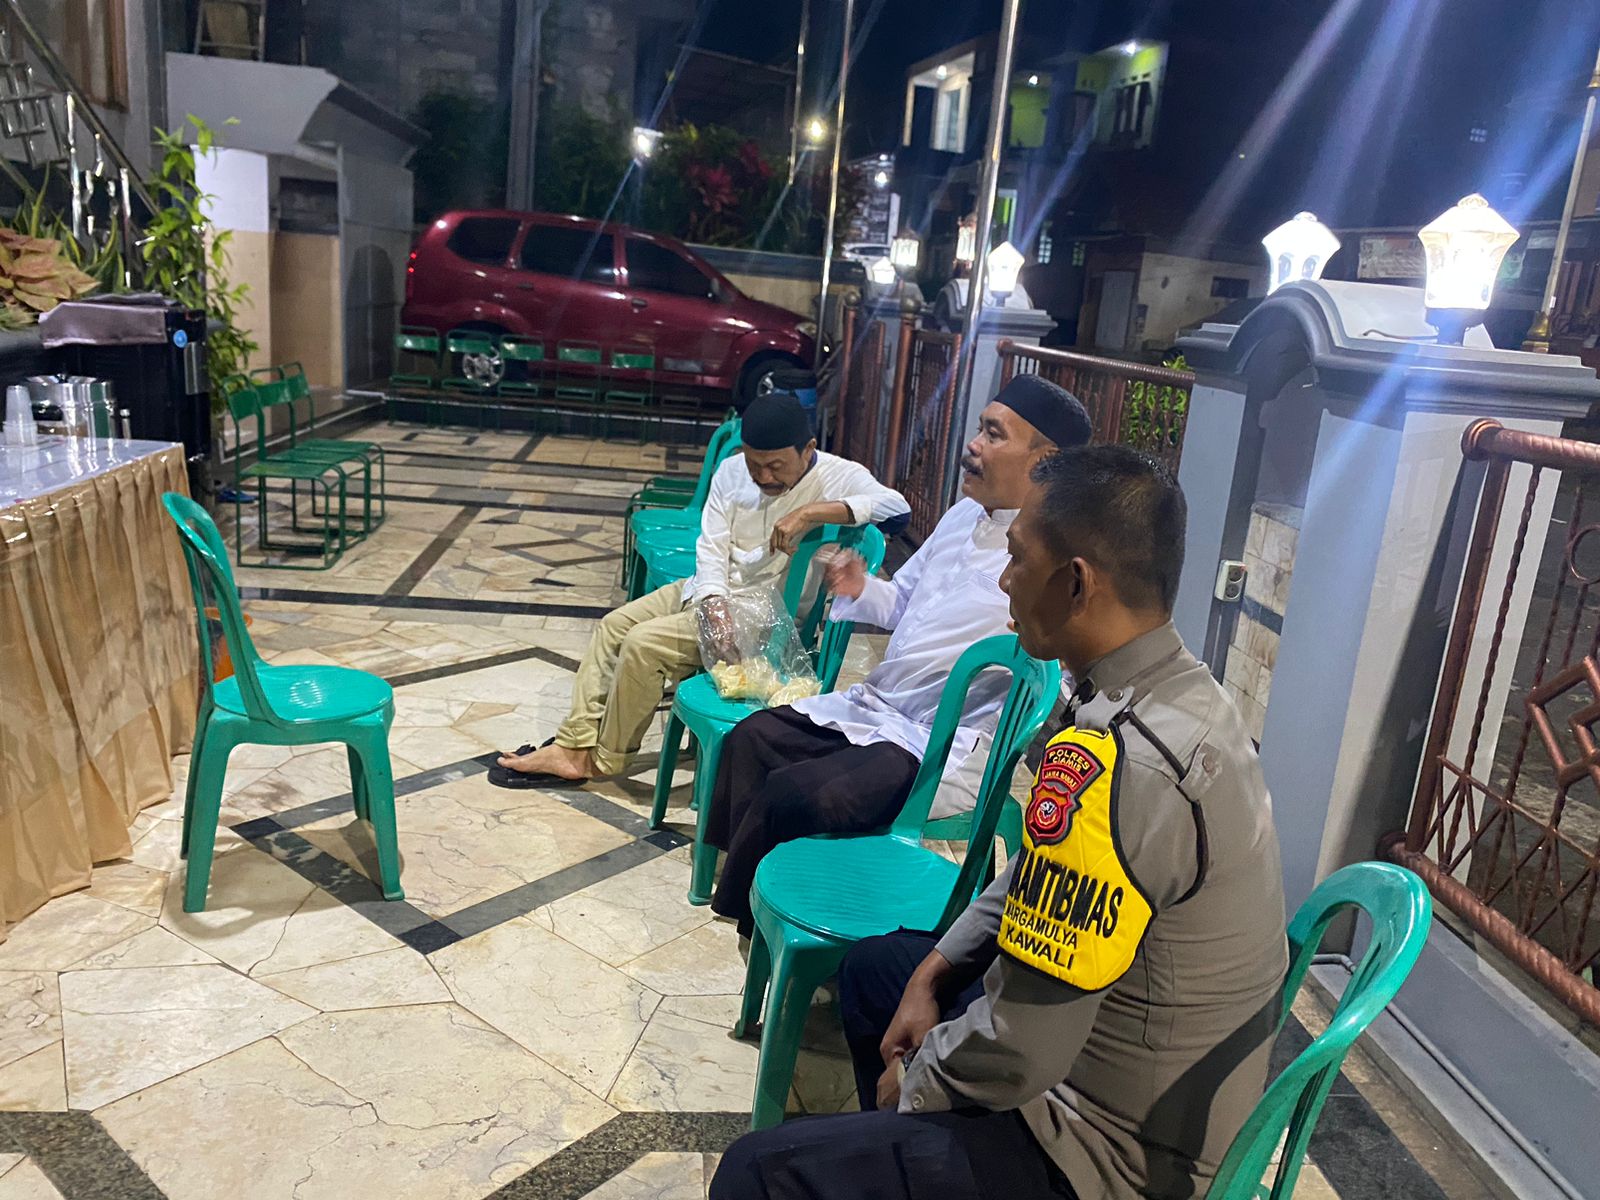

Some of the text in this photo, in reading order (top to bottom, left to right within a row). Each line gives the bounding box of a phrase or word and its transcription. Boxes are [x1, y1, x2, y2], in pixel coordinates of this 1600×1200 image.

[1049, 749, 1091, 770] POLRES
[1053, 757, 1082, 772] CIAMIS
[1006, 924, 1074, 970] KAWALI
